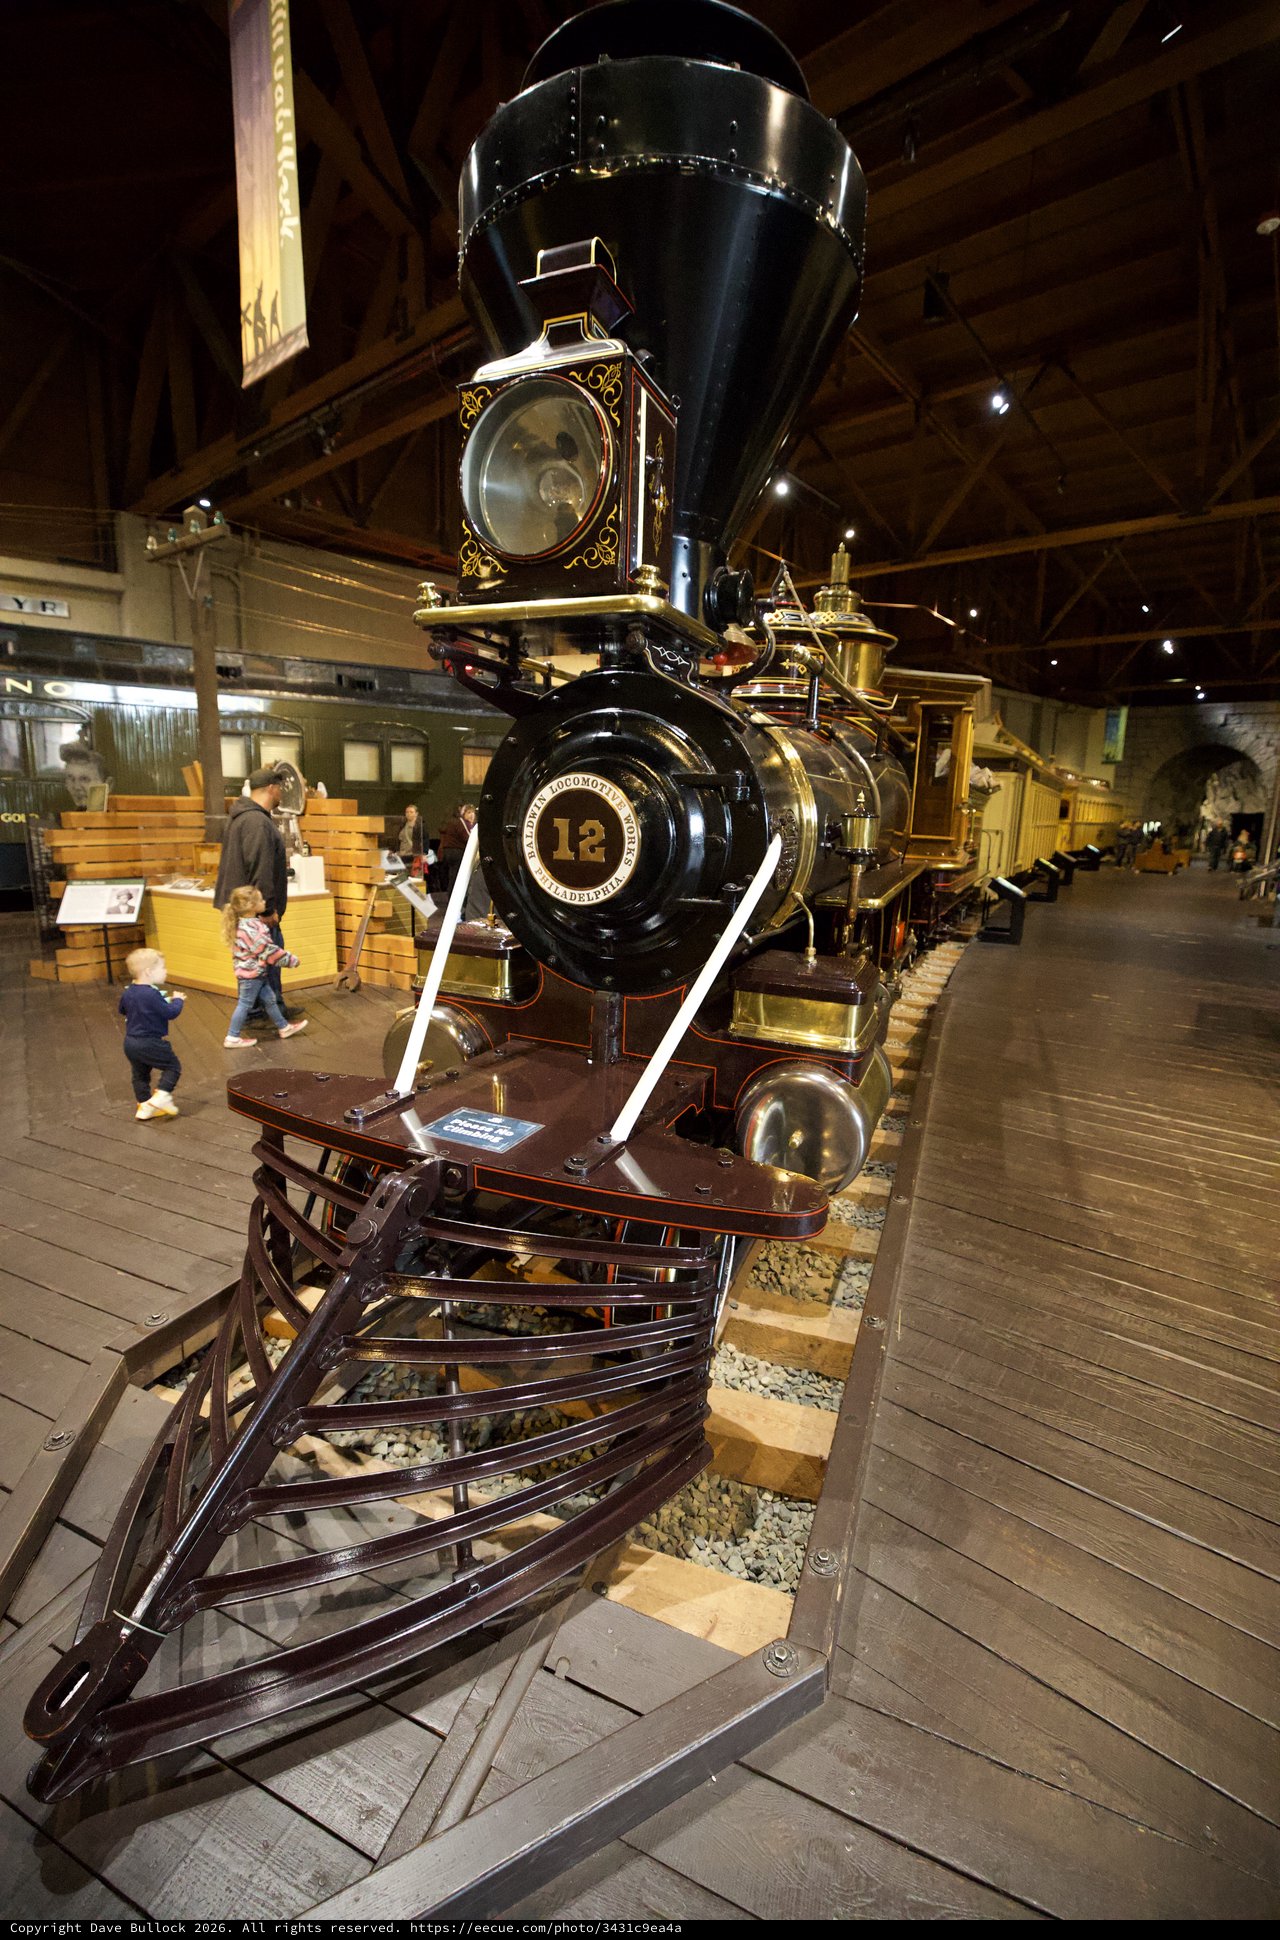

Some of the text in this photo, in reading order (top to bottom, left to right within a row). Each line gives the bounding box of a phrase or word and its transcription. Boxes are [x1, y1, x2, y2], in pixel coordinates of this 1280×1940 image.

[527, 776, 636, 867] BALDWIN LOCOMOTIVE WORKS
[553, 817, 606, 863] 12
[443, 1125, 504, 1143] Climbing
[450, 1118, 514, 1137] Please No
